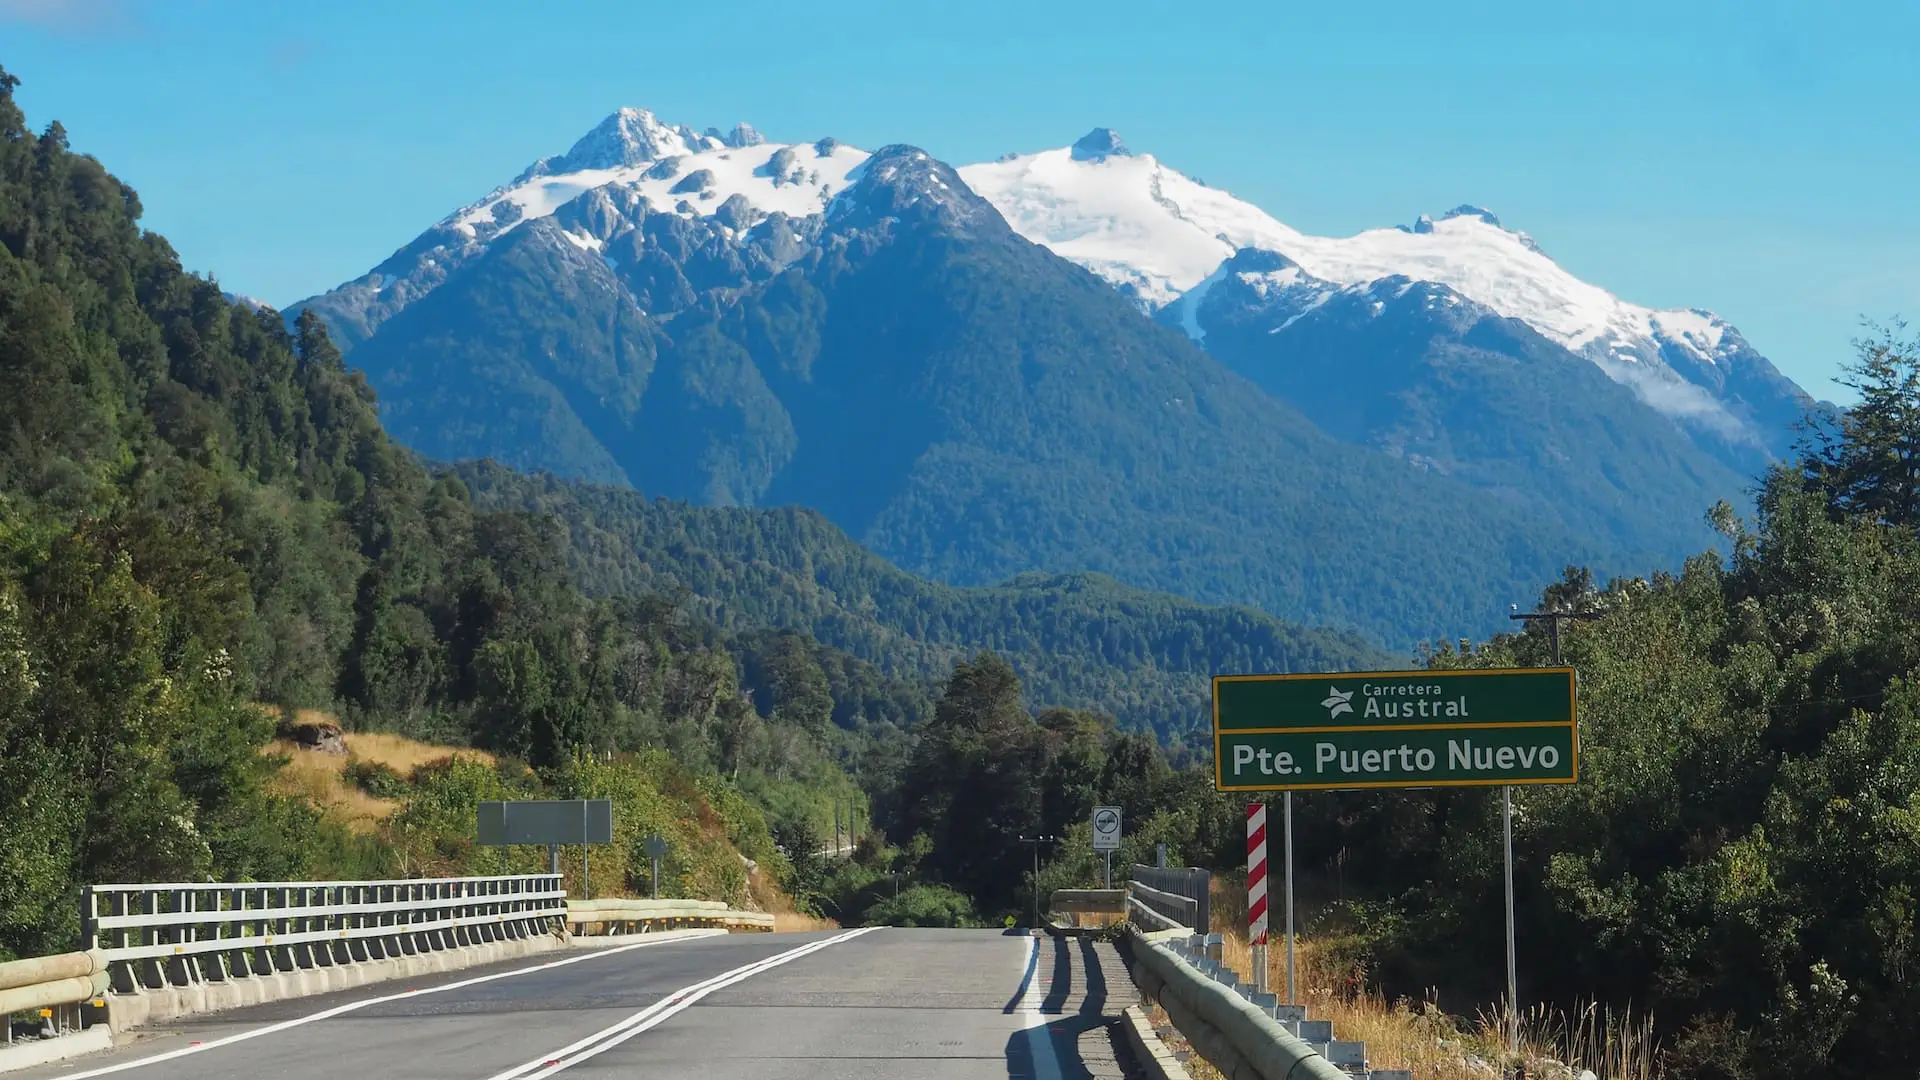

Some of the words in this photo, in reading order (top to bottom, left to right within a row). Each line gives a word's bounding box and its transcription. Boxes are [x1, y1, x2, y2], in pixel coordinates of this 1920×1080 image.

[1362, 683, 1442, 696] Carretera
[1363, 695, 1469, 718] Austral
[1233, 744, 1302, 776] Pte.
[1315, 742, 1436, 773] Puerto
[1448, 739, 1559, 771] Nuevo
